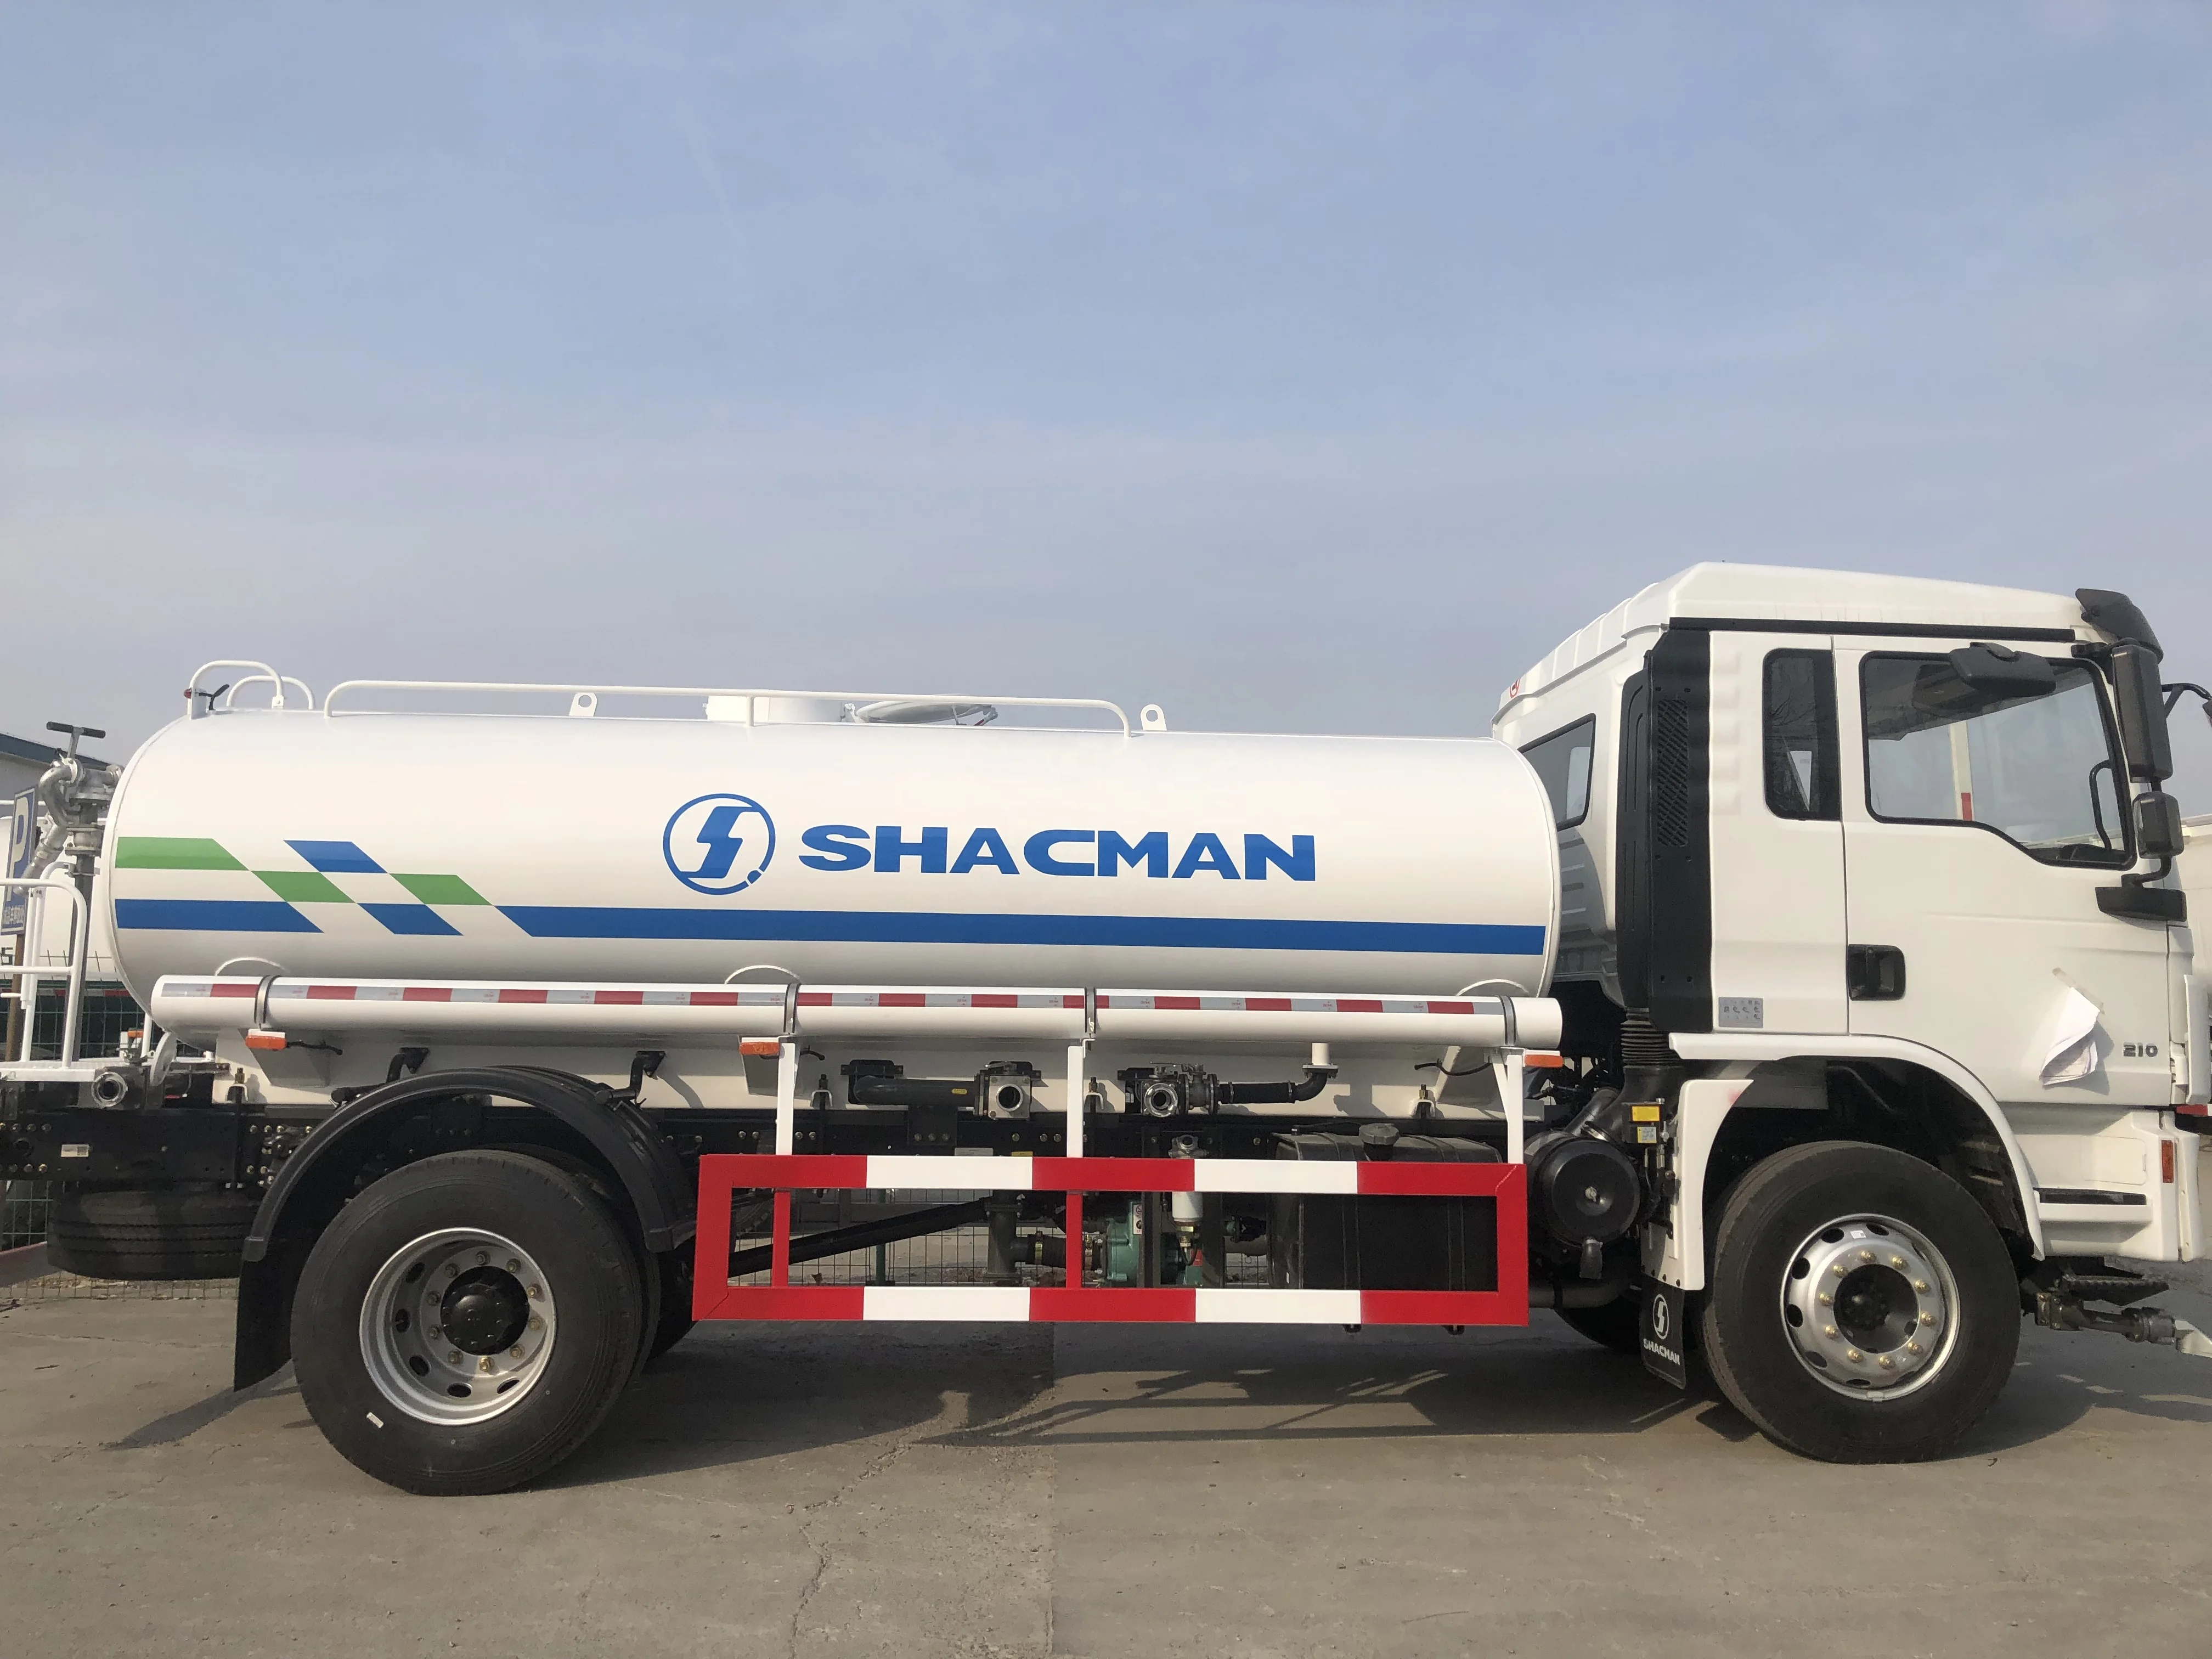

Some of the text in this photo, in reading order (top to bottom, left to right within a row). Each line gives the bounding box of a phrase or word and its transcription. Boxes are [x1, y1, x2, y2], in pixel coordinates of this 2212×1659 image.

[5, 797, 29, 902] P
[798, 824, 1316, 882] SHACMAN
[2123, 1042, 2158, 1057] 210
[1644, 1339, 1680, 1365] SHACMAN
